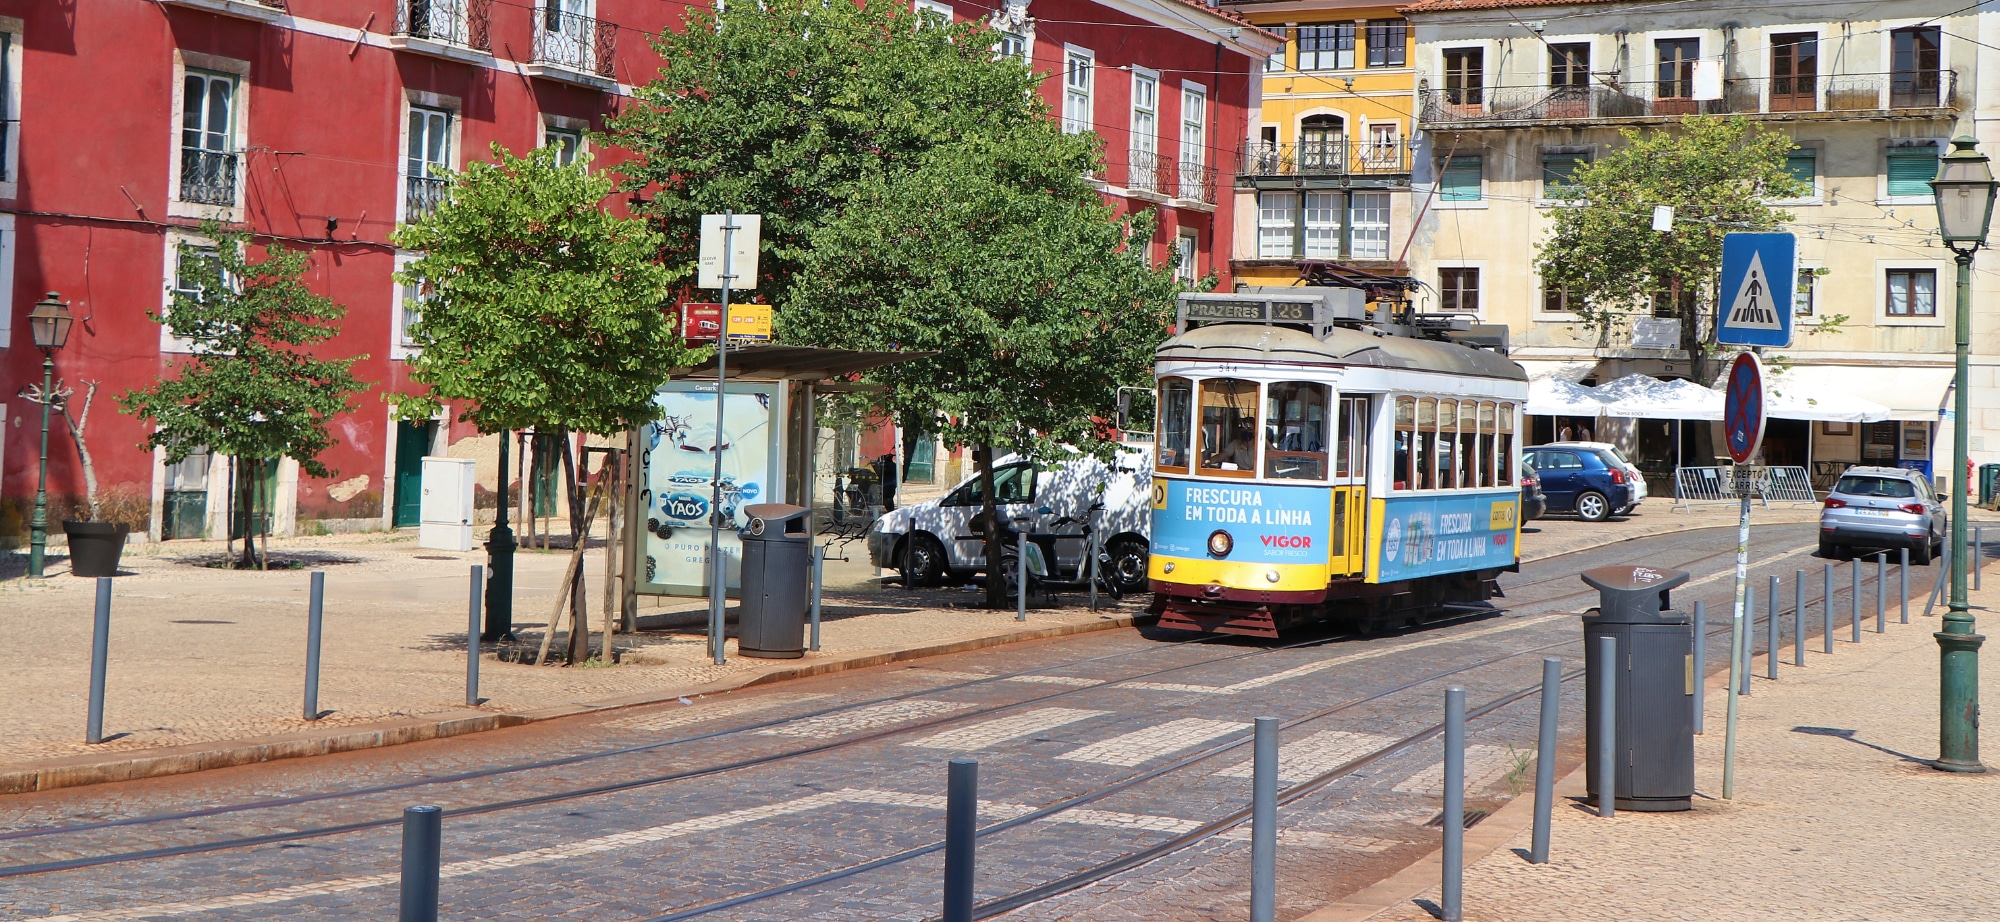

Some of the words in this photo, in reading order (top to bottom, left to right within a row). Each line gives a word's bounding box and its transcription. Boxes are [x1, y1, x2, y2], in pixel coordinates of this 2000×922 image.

[1191, 304, 1260, 319] PRAZERES
[1279, 303, 1302, 319] 28
[1219, 364, 1237, 373] 544
[1725, 470, 1762, 479] EXCEPTO
[1728, 481, 1759, 490] CARRIS
[1186, 487, 1262, 507] FRESCURA
[666, 500, 703, 516] YAOS
[1185, 505, 1202, 521] EM
[1207, 506, 1247, 524] TODA
[1251, 508, 1262, 525] A
[1266, 509, 1312, 526] LINHA
[1440, 513, 1472, 535] FRESCURA
[674, 543, 700, 551] PURO
[705, 545, 740, 553] PAZER
[1260, 534, 1312, 548] VIGOR
[1263, 549, 1284, 557] SABOR
[1285, 549, 1308, 557] FRESCO
[1437, 540, 1446, 561] EM
[1447, 539, 1463, 561] TODA
[1463, 538, 1468, 558] A
[1469, 536, 1486, 558] LINHA
[685, 556, 710, 564] GREG
